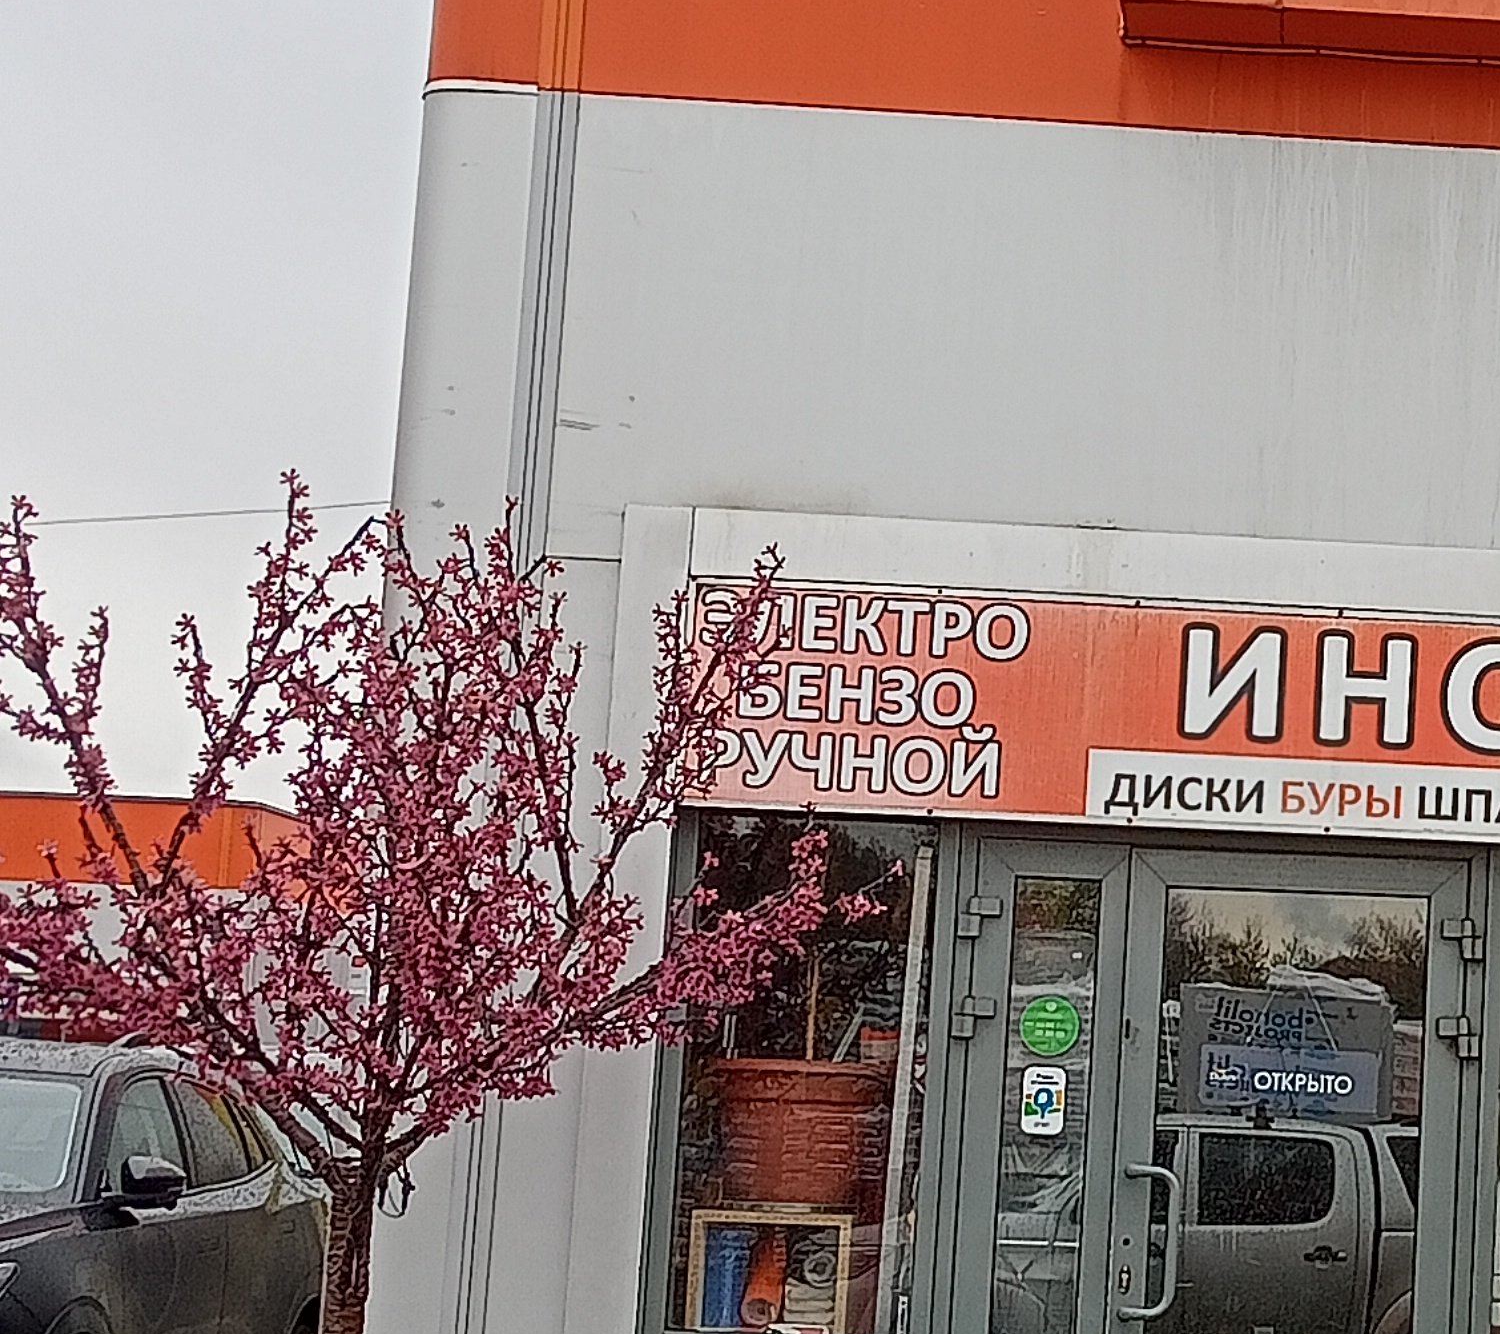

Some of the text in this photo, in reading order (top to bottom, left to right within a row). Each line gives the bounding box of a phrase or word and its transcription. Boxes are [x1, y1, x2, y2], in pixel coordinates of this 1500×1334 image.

[701, 588, 1030, 661] ЭЛЕКТРО
[736, 661, 976, 730] БЕНЗО
[701, 724, 1003, 799] РУЧНОЙ
[1104, 772, 1265, 817] ДИСКИ
[1280, 780, 1402, 819] БУРЫ
[1253, 1070, 1353, 1095] ОТКРЫТО
